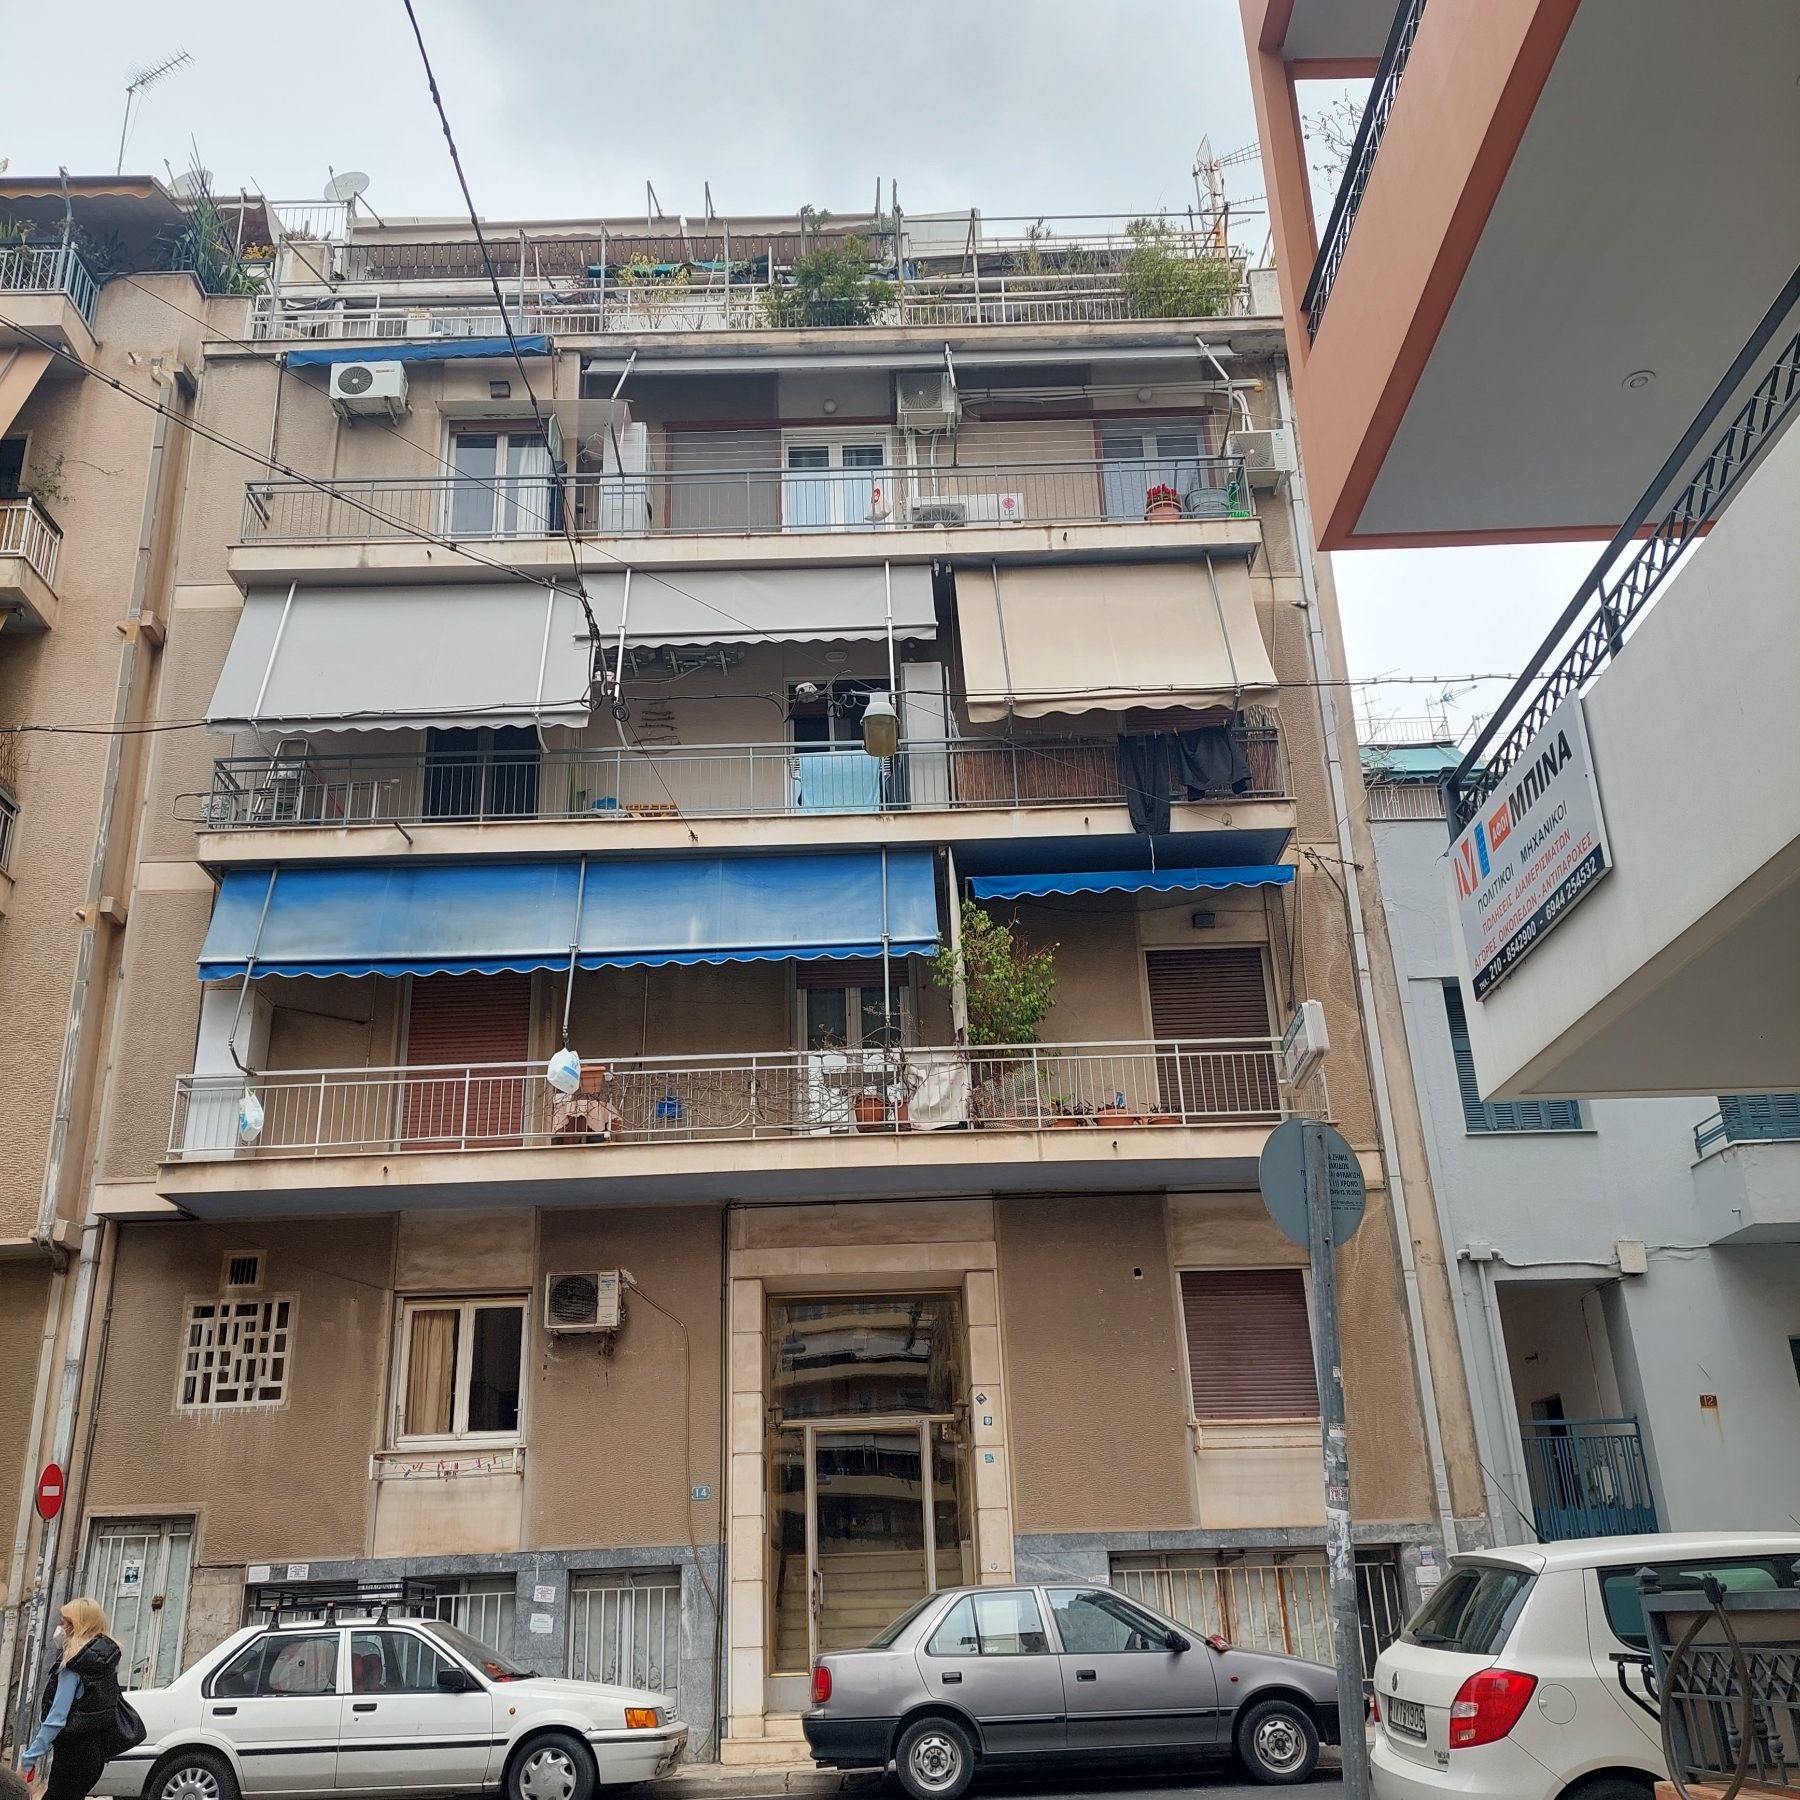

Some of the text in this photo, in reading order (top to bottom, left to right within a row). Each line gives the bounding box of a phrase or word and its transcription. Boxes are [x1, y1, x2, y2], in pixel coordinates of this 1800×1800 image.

[1491, 729, 1572, 843] ΑΦΟΙ ΜΠΙΝΑ
[1474, 937, 1497, 970] ΑΓΟΡΕΣ
[1498, 893, 1537, 942] ΟΙΚΟΠΕΔΩΝ
[1541, 831, 1593, 898] ΑΝΤΙΠΑΡΟΧΕΣ
[1478, 799, 1567, 914] ΠΟΛΙΤΙΚΟΙ ΜΗΧΑΝΙΚΟΙ
[1482, 828, 1571, 935] ΠΩΛΗΣΕΙΣ ΔΙΑΜΕΡΙΣΜΑΤΩΝ
[1489, 957, 1502, 980] 210
[1506, 920, 1536, 962] 8542900
[1545, 889, 1566, 921] 6944
[1565, 856, 1597, 900] 254532
[1703, 1395, 1714, 1406] 12
[695, 1488, 707, 1498] 14
